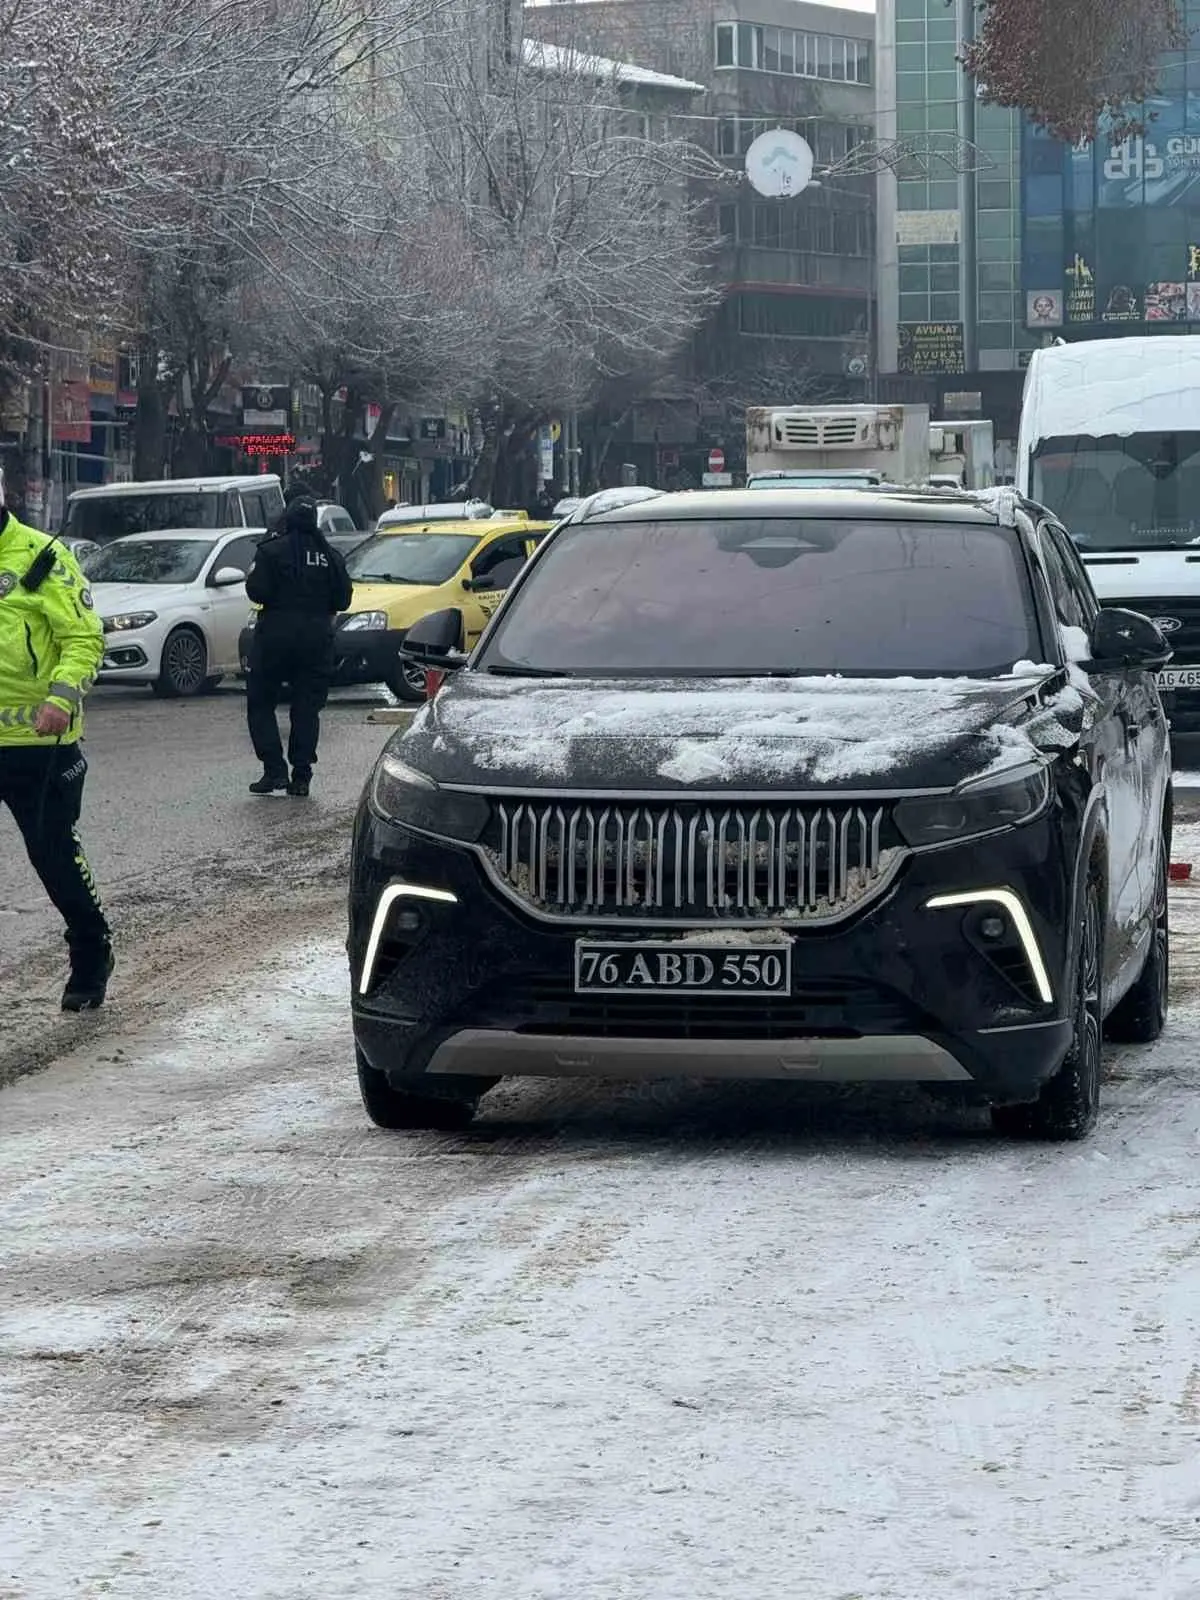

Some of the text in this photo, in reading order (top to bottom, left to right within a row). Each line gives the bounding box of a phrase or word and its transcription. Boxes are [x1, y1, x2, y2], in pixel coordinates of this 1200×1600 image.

[915, 325, 959, 335] AVUKAT
[914, 350, 964, 360] AVUKAT
[582, 952, 782, 986] 76 ABD 550
